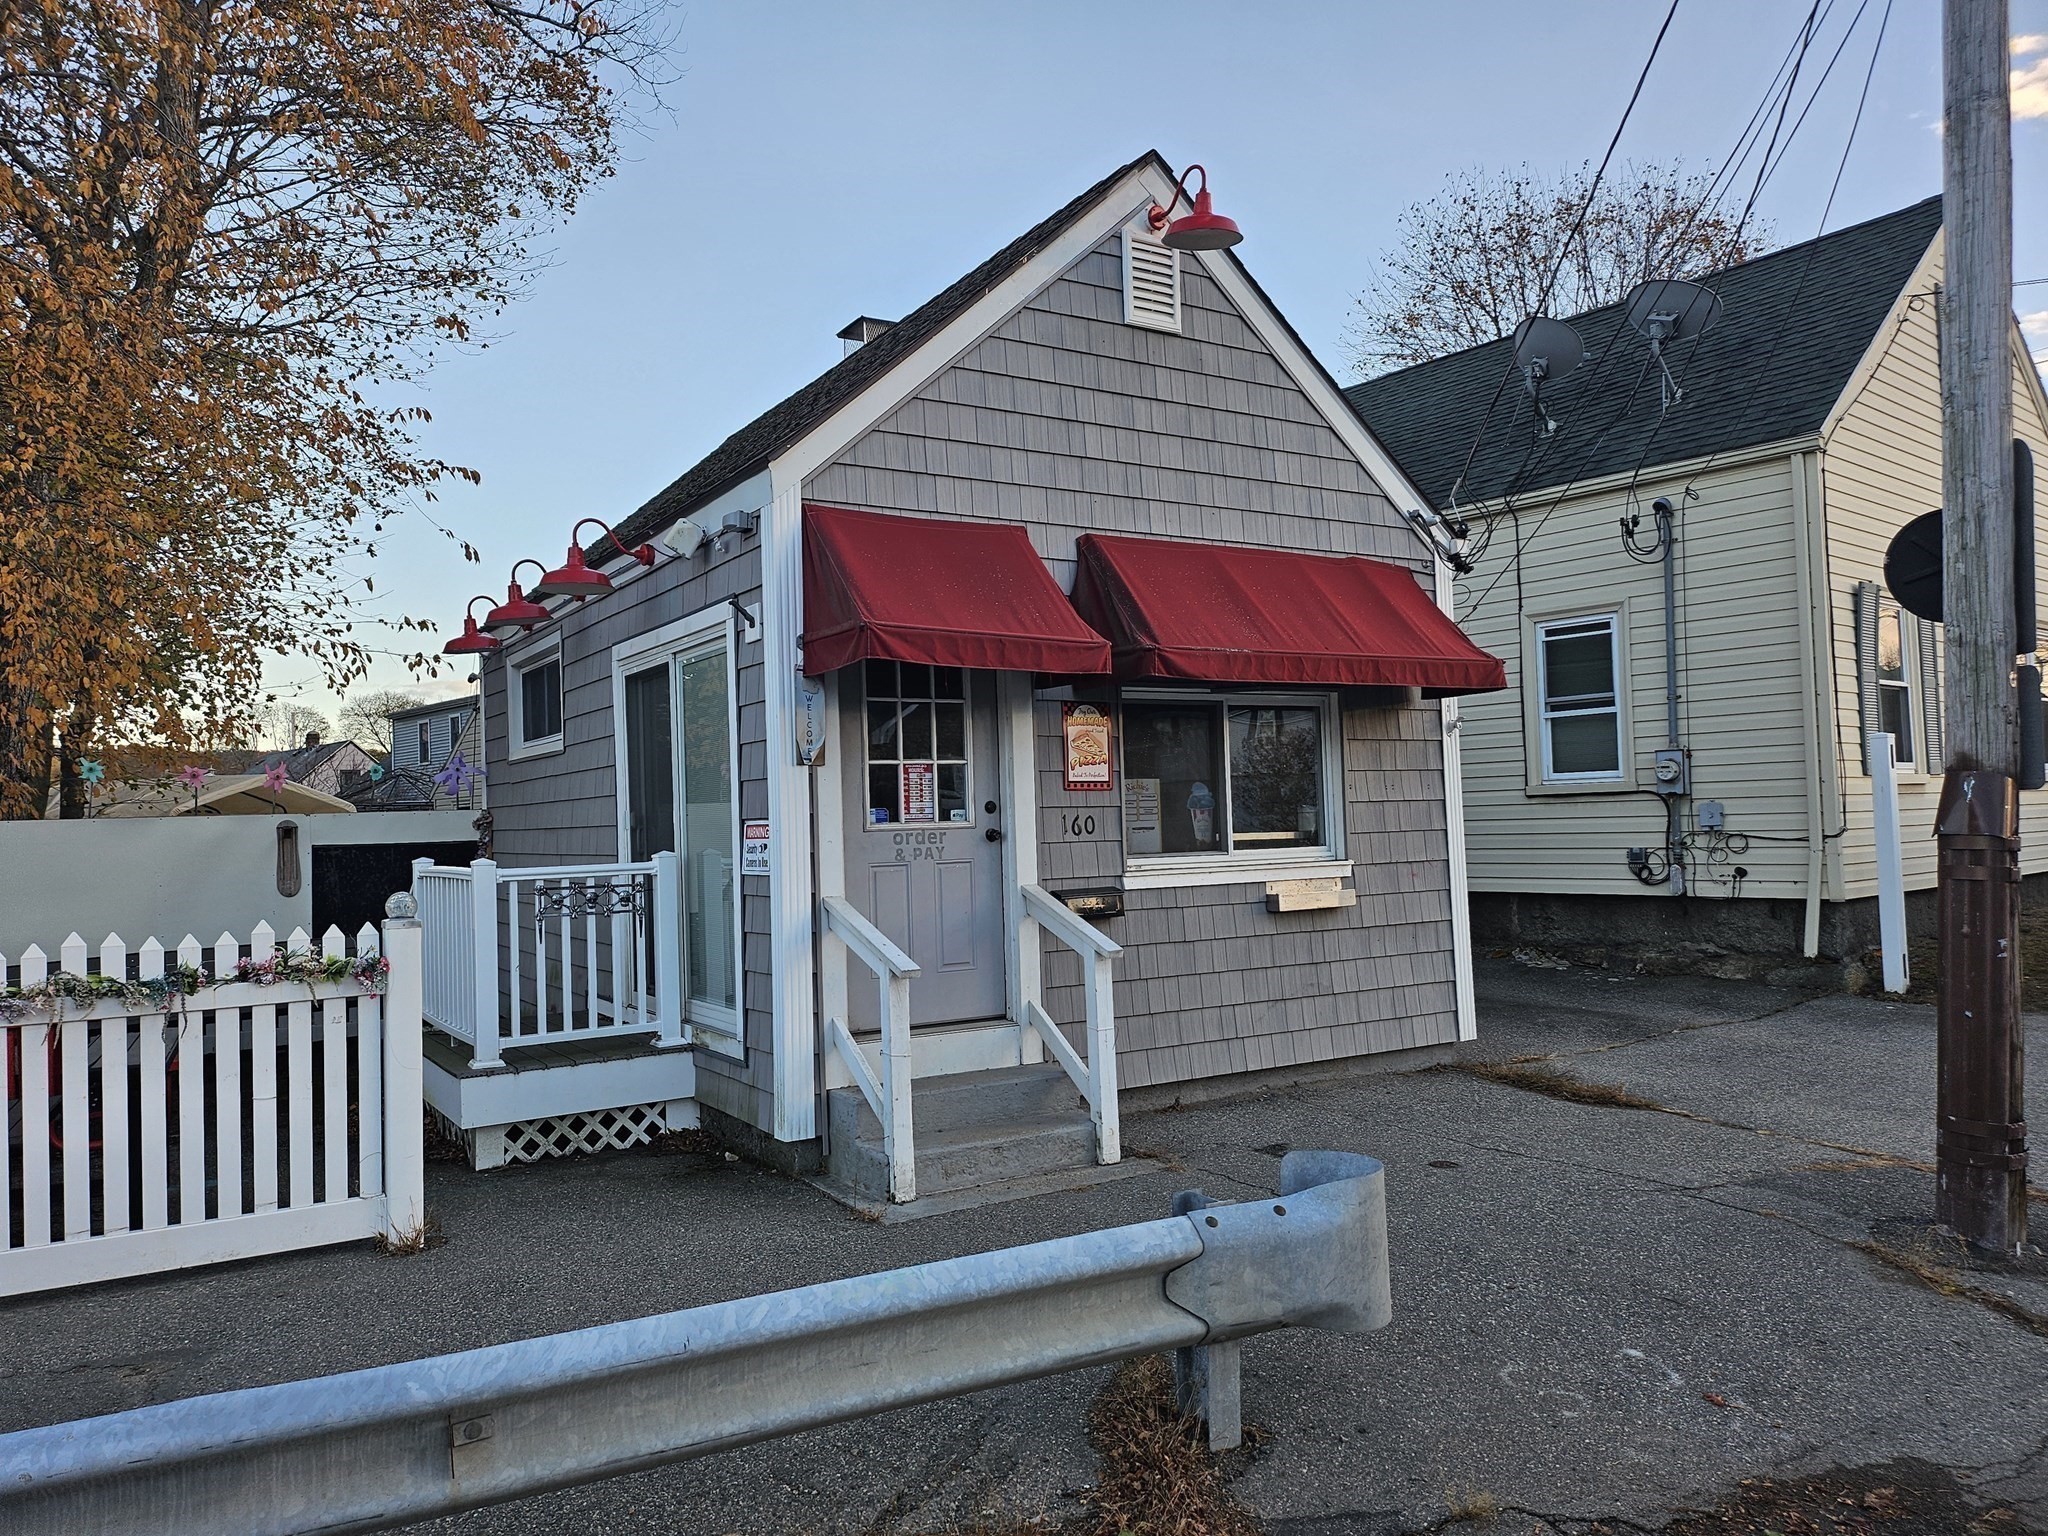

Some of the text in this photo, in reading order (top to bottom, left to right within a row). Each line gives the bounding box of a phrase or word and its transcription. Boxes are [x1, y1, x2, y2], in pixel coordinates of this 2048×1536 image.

[804, 694, 814, 756] WELCOME
[1066, 715, 1109, 728] HOMEMADE
[1070, 753, 1108, 771] PIZZA
[746, 826, 769, 838] WARNING
[1062, 813, 1096, 836] 160
[892, 829, 947, 846] order
[894, 846, 945, 862] & PAY
